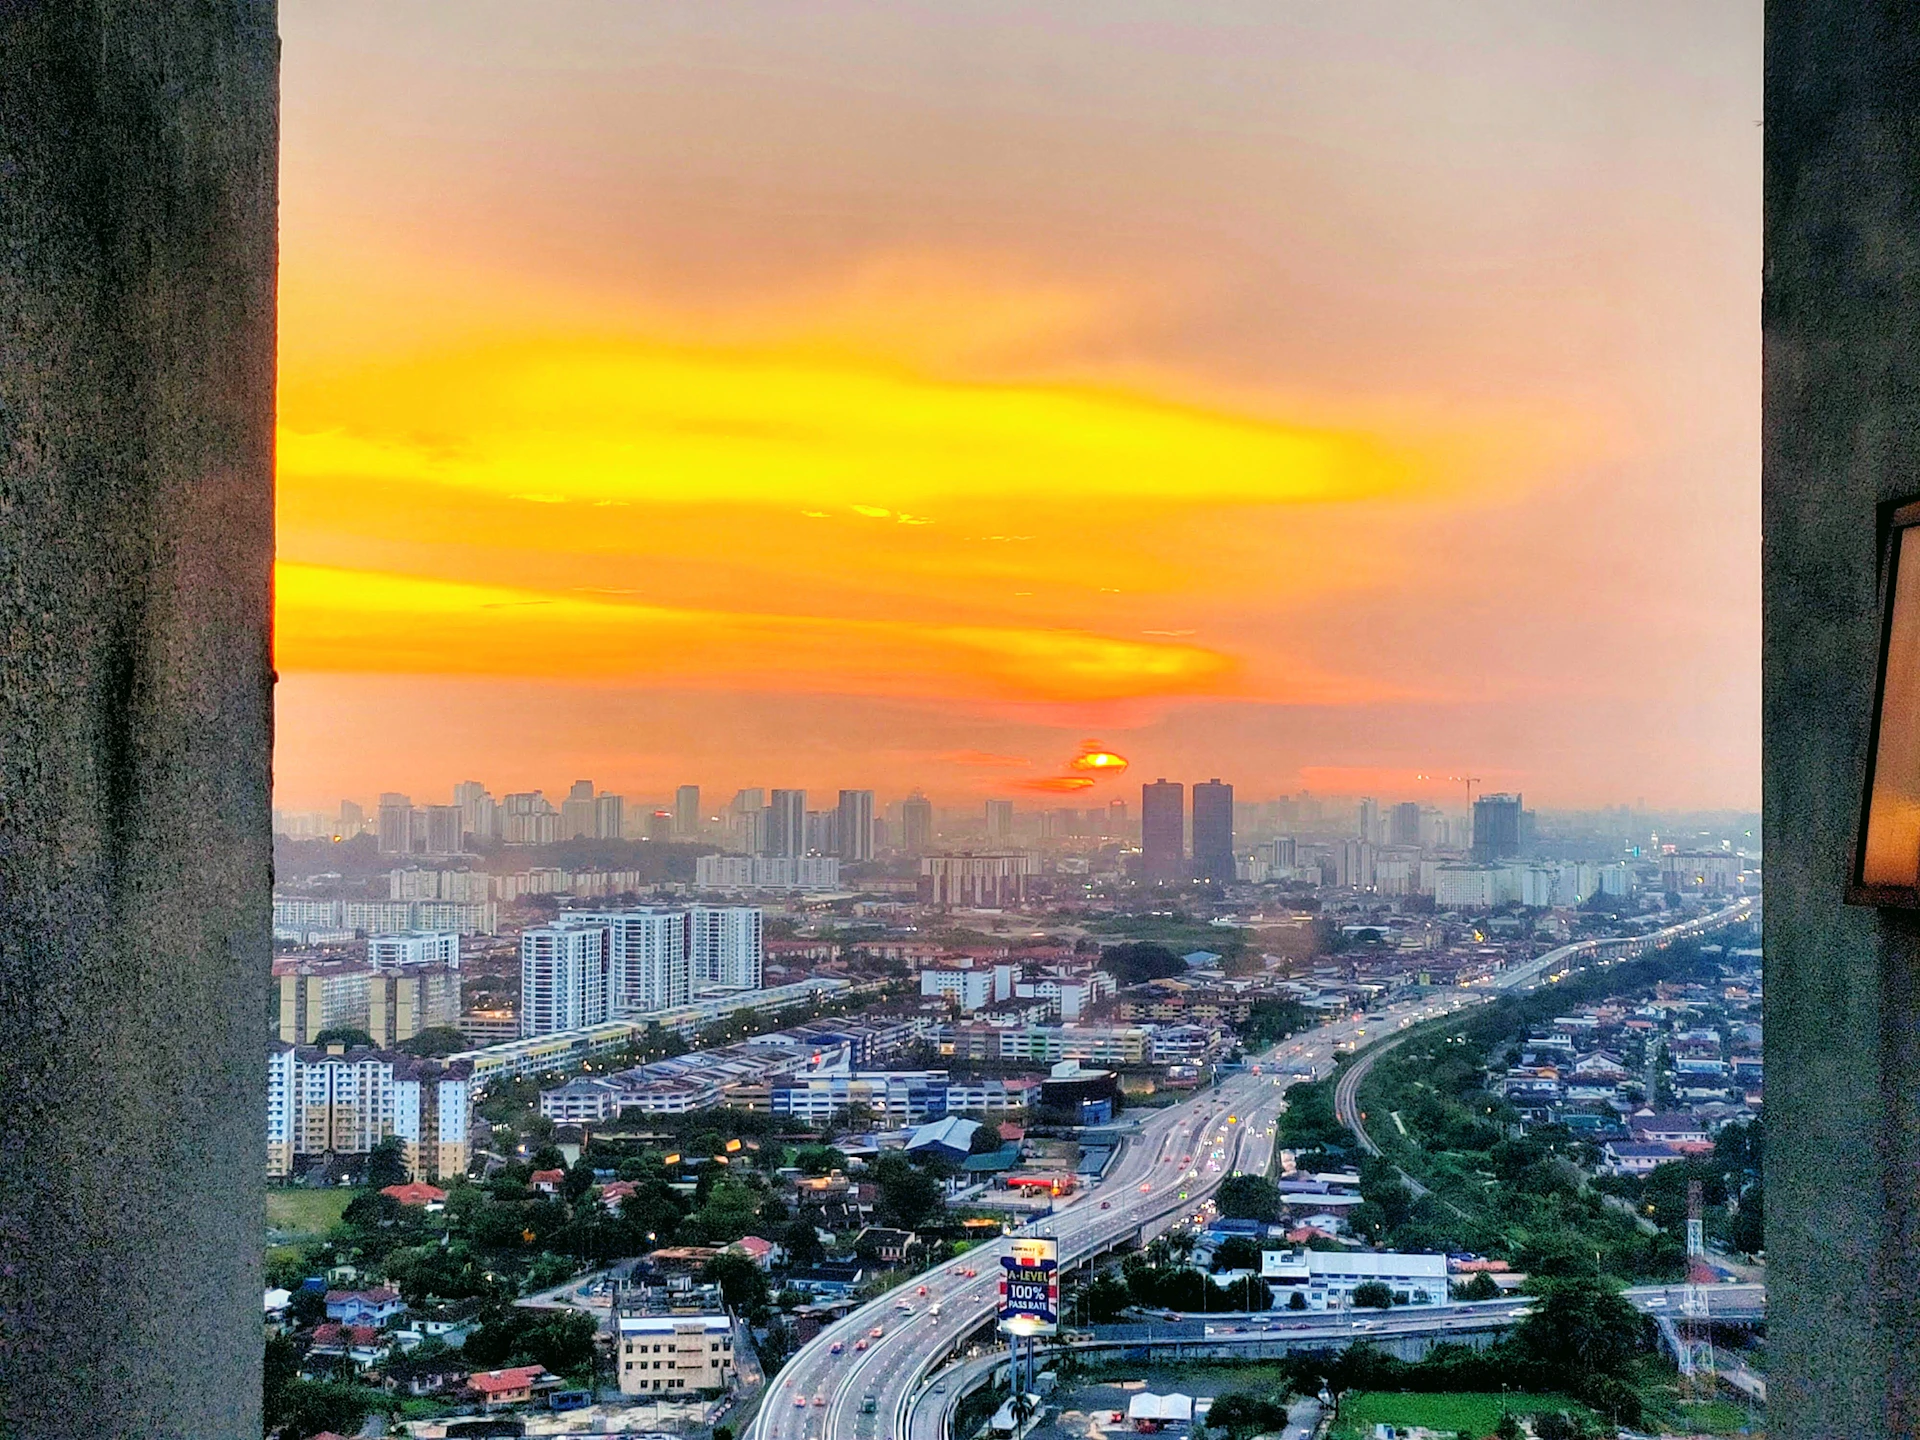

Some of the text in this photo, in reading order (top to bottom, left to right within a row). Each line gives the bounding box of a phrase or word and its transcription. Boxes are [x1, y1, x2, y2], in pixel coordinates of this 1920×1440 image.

[1011, 1284, 1045, 1300] 100%
[1009, 1300, 1047, 1310] PASS RATE
